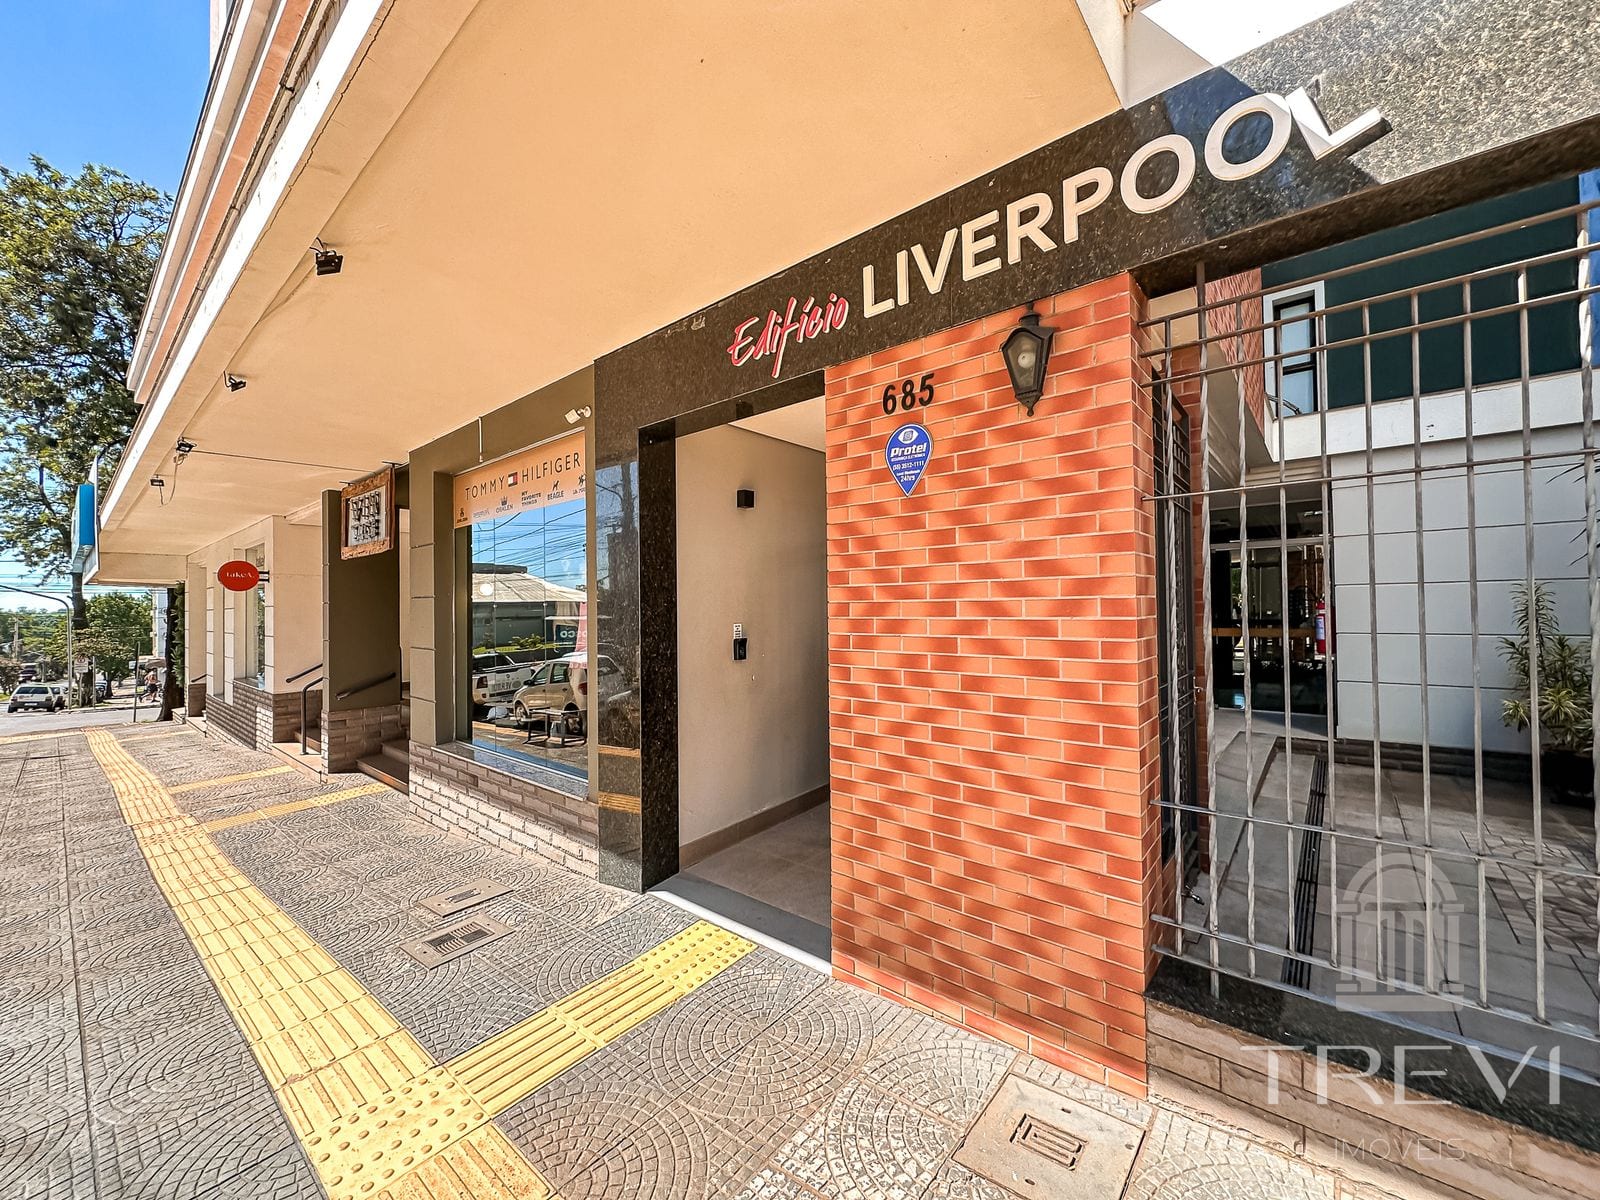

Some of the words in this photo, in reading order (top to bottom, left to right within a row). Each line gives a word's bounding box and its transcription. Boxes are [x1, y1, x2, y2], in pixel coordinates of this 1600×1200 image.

[727, 293, 849, 378] Edifício
[862, 86, 1386, 319] LIVERPOOL
[883, 373, 935, 415] 685
[890, 442, 927, 457] Protel
[465, 476, 505, 500] TOMMY
[522, 452, 581, 484] HILFIGER
[521, 492, 542, 502] FAVORITE
[547, 490, 565, 501] BEAGLE
